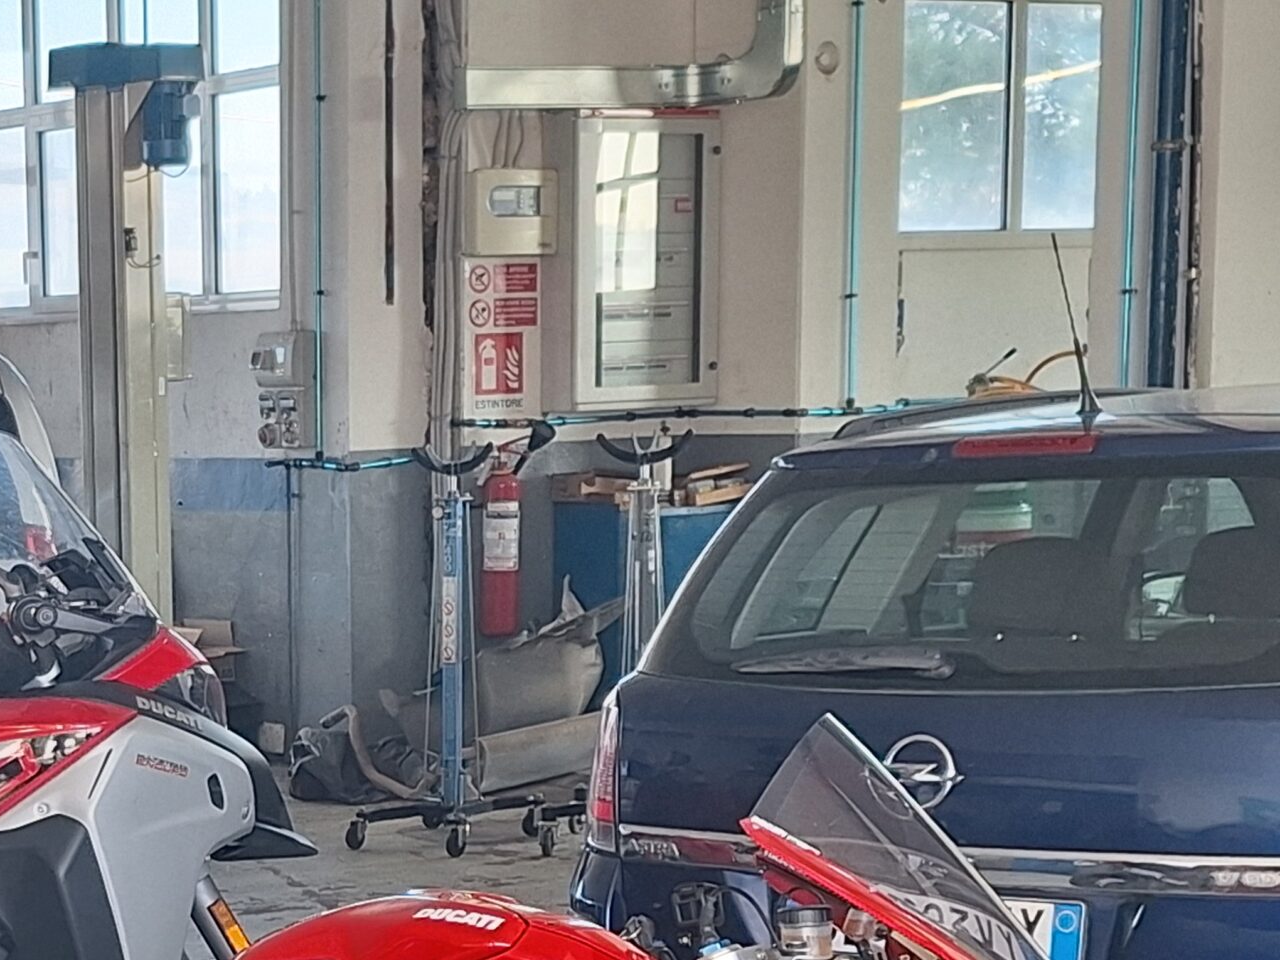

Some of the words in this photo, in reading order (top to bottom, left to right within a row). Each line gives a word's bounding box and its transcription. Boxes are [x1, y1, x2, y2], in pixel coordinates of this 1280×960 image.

[474, 398, 524, 410] ESTINTORE
[135, 696, 203, 731] DUCATI
[412, 908, 506, 931] DUCATI
